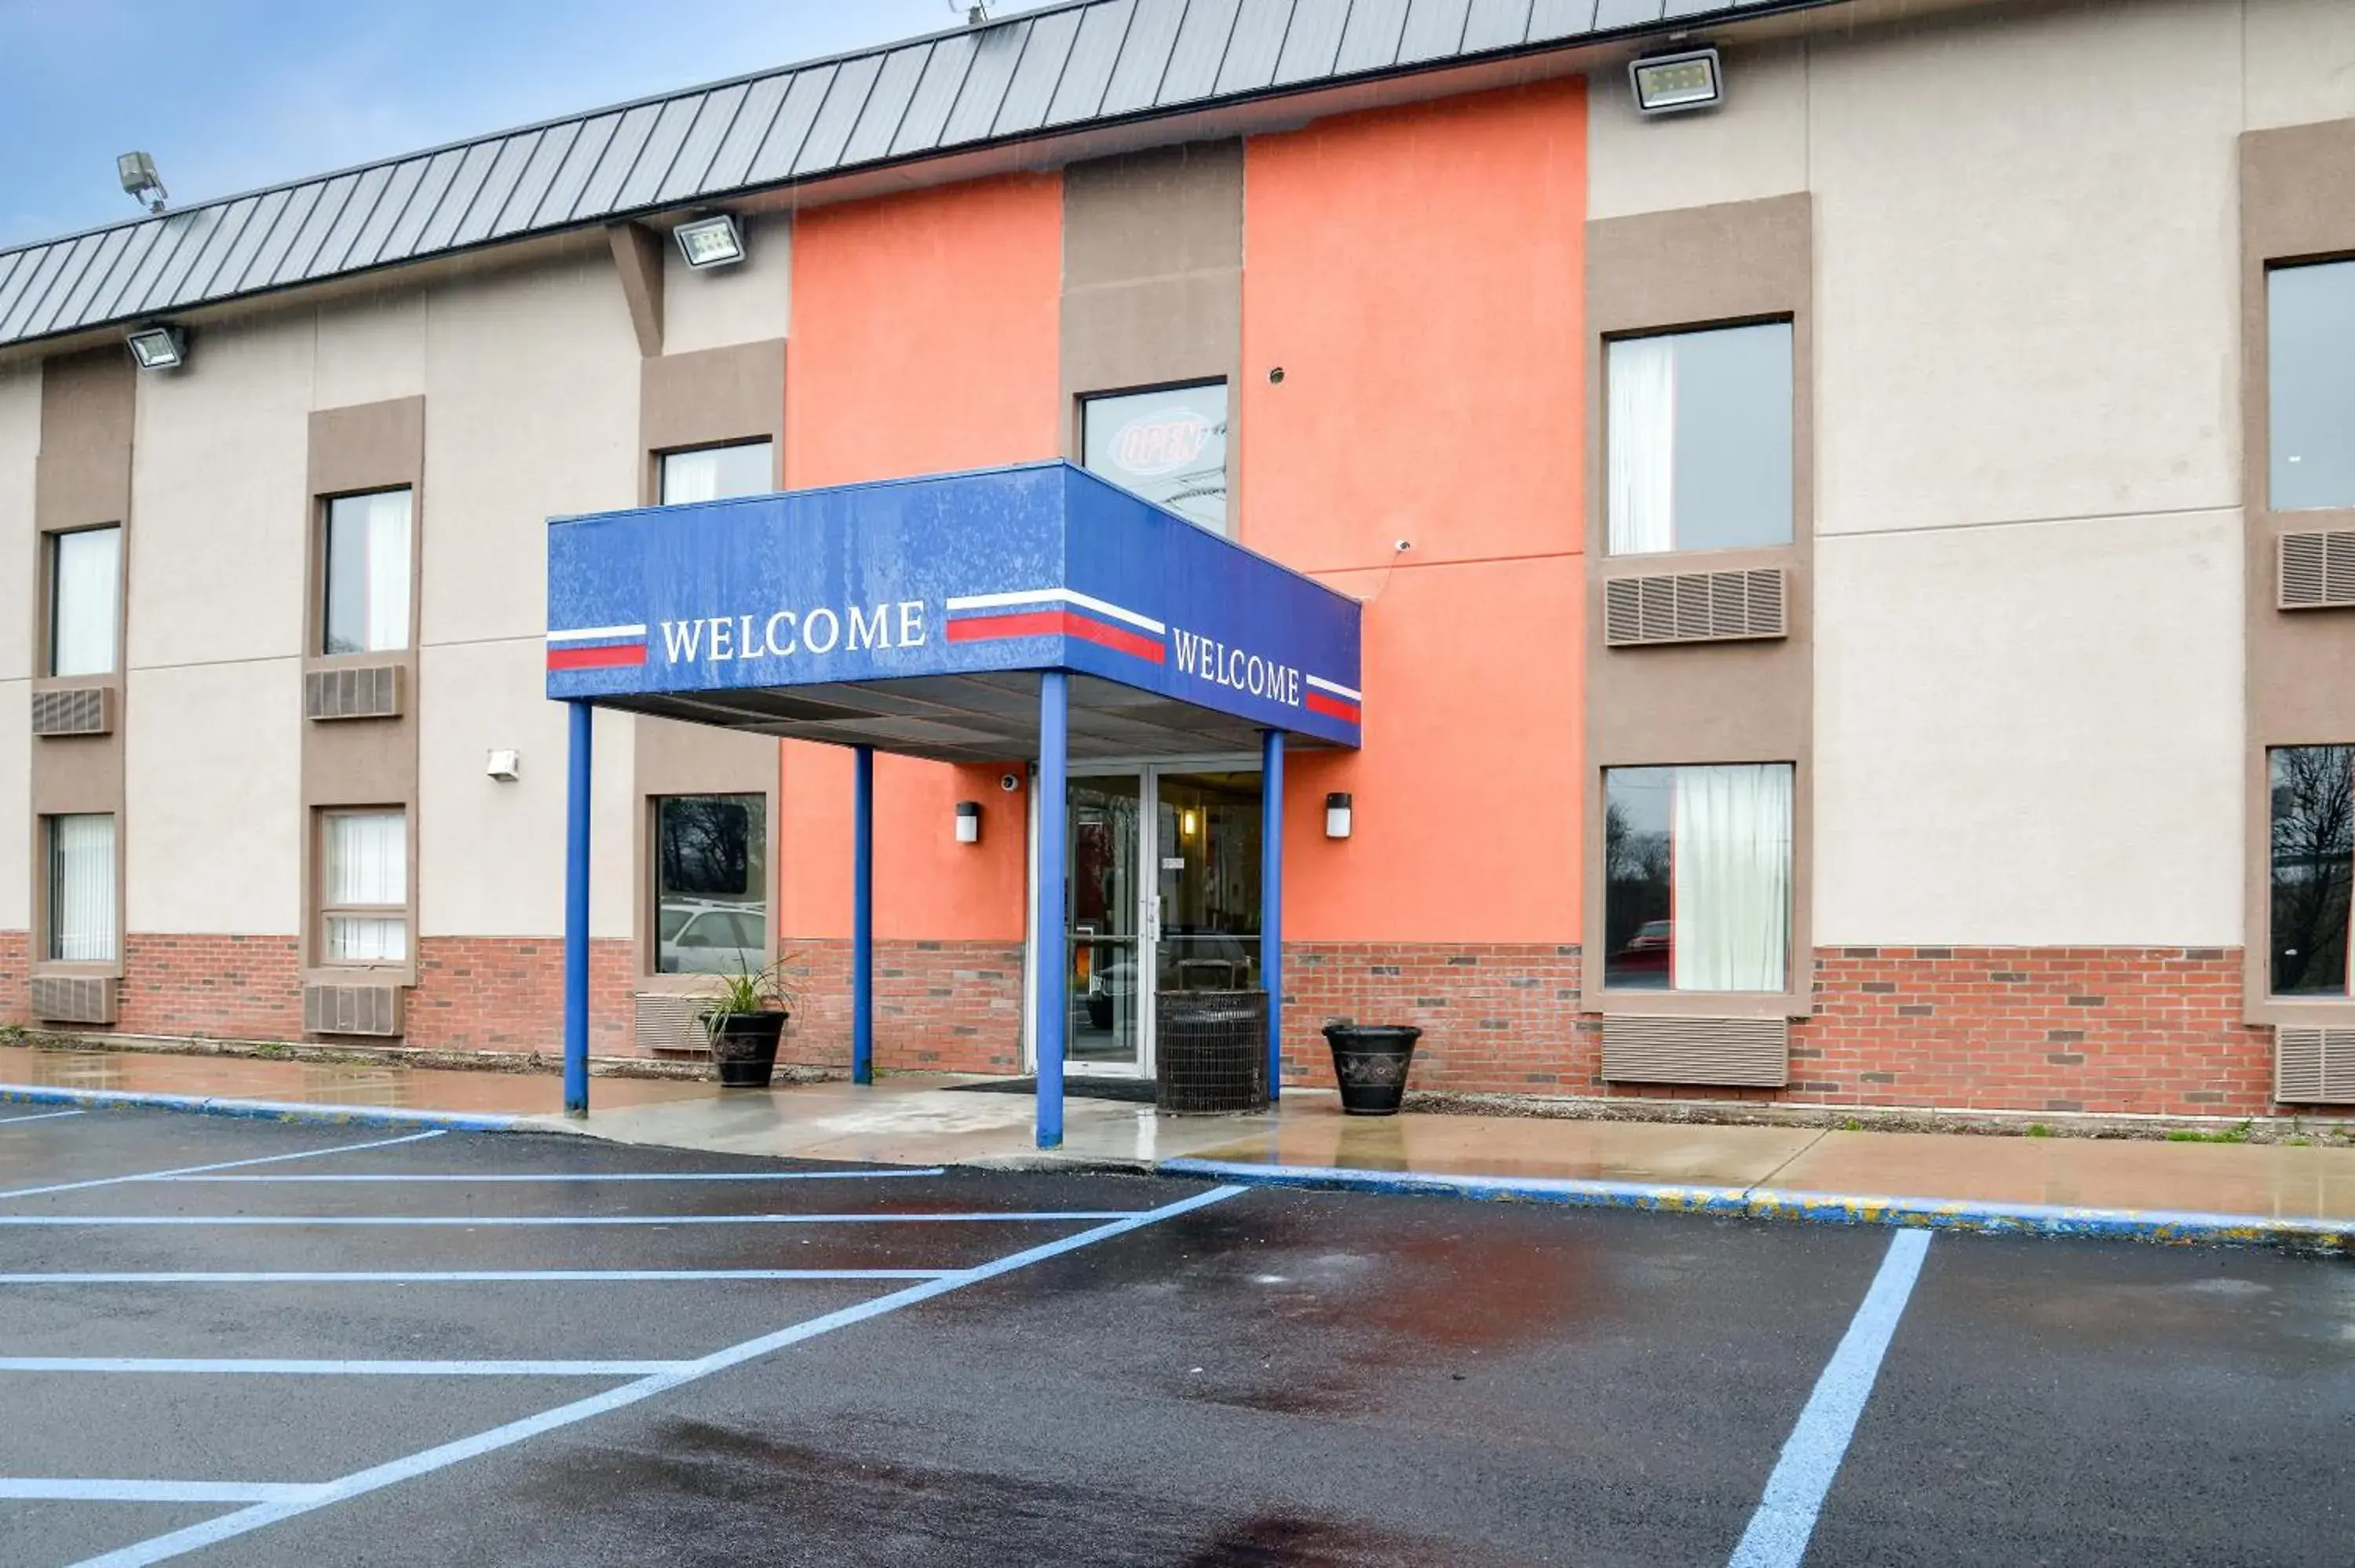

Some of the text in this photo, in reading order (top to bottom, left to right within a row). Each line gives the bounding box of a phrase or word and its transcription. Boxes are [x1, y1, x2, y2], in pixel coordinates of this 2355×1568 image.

[1120, 422, 1204, 465] OPEN
[660, 600, 928, 664] WELCOME
[1173, 627, 1299, 706] WELCOME
